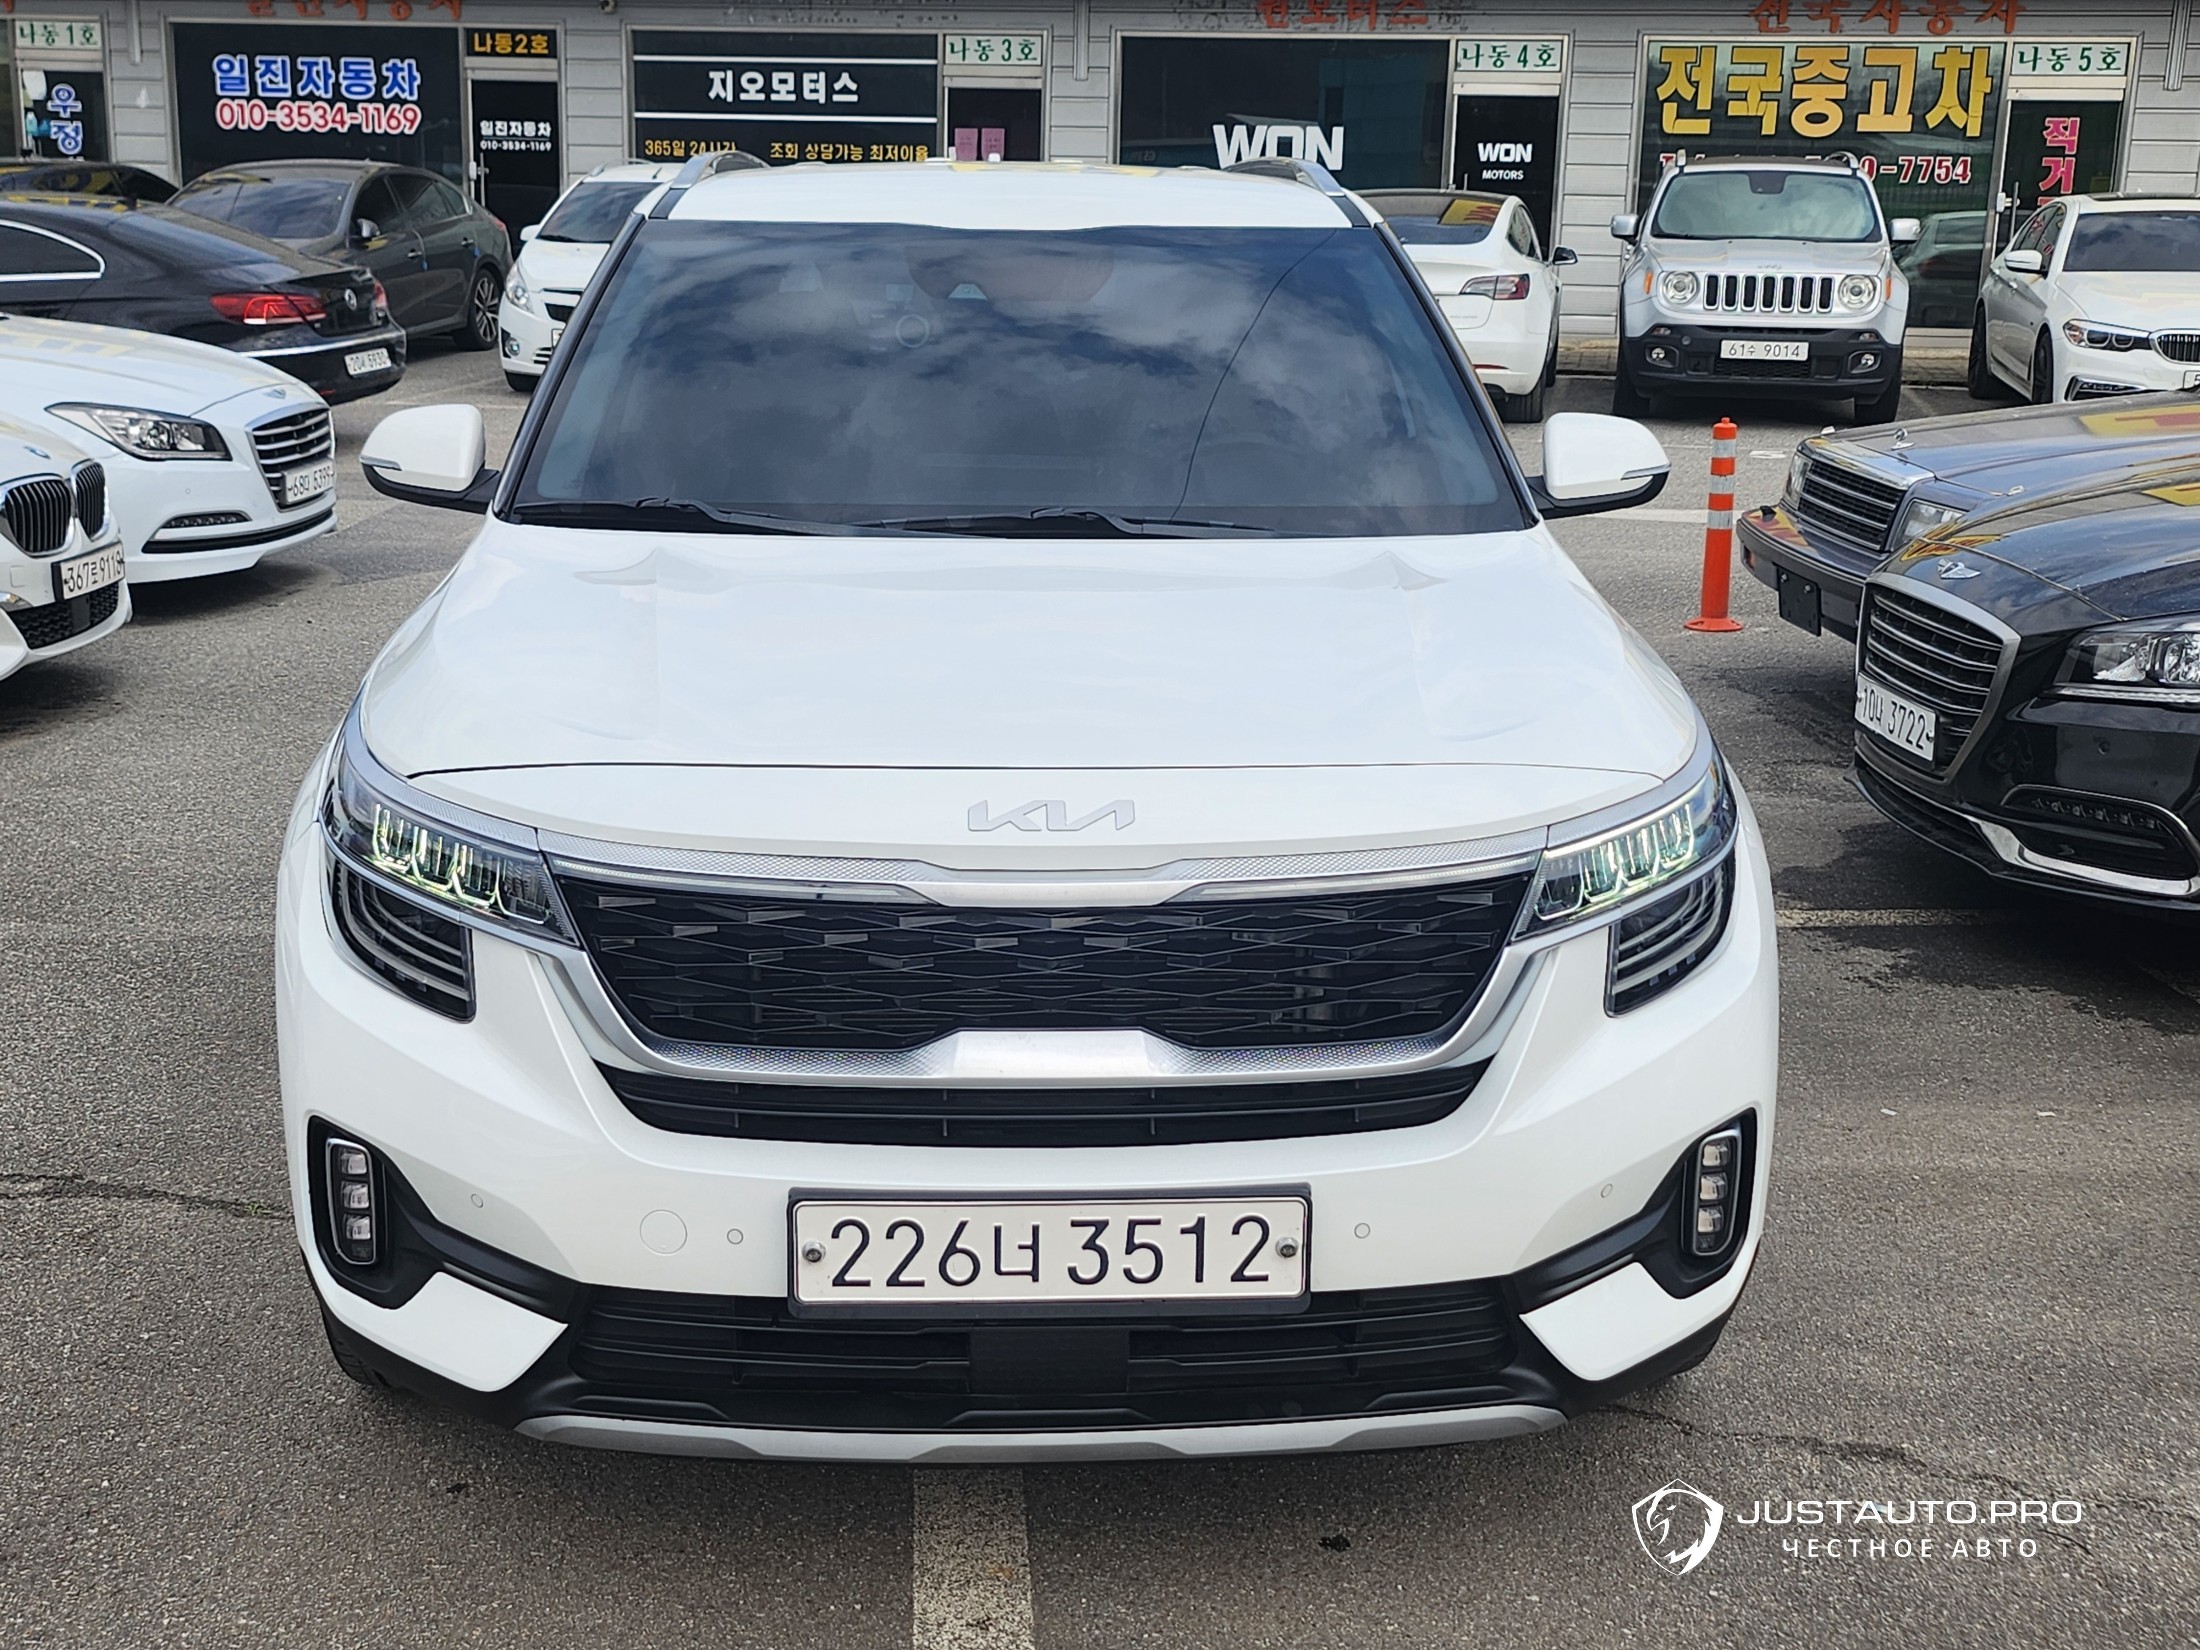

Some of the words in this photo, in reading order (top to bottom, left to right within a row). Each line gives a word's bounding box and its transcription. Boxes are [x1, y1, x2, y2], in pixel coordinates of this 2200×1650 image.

[19, 22, 99, 47] 나동1호
[473, 32, 549, 54] 나동2호
[949, 37, 1038, 62] 나동3호
[1461, 43, 1558, 69] 나동4호
[2018, 46, 2122, 73] 나동5호
[212, 53, 422, 101] 일진자동차
[707, 69, 859, 105] 지오모터스
[1655, 45, 1992, 138] 전국중고차
[46, 83, 84, 161] 우정
[215, 98, 422, 135] 010-3534-1169
[480, 119, 552, 138] 일진자동차
[480, 140, 552, 152] 010-3534-1169
[645, 140, 686, 157] 365일
[770, 141, 799, 160] 조회
[804, 143, 864, 161] 상담가능
[1212, 124, 1345, 171] WON
[1477, 142, 1533, 163] WON
[1482, 169, 1525, 181] MOTORS
[2037, 117, 2080, 208] 직거
[1763, 343, 1801, 358] 9014
[1887, 699, 1927, 751] 3722
[830, 1217, 1040, 1288] 226너
[1066, 1212, 1272, 1286] 3512
